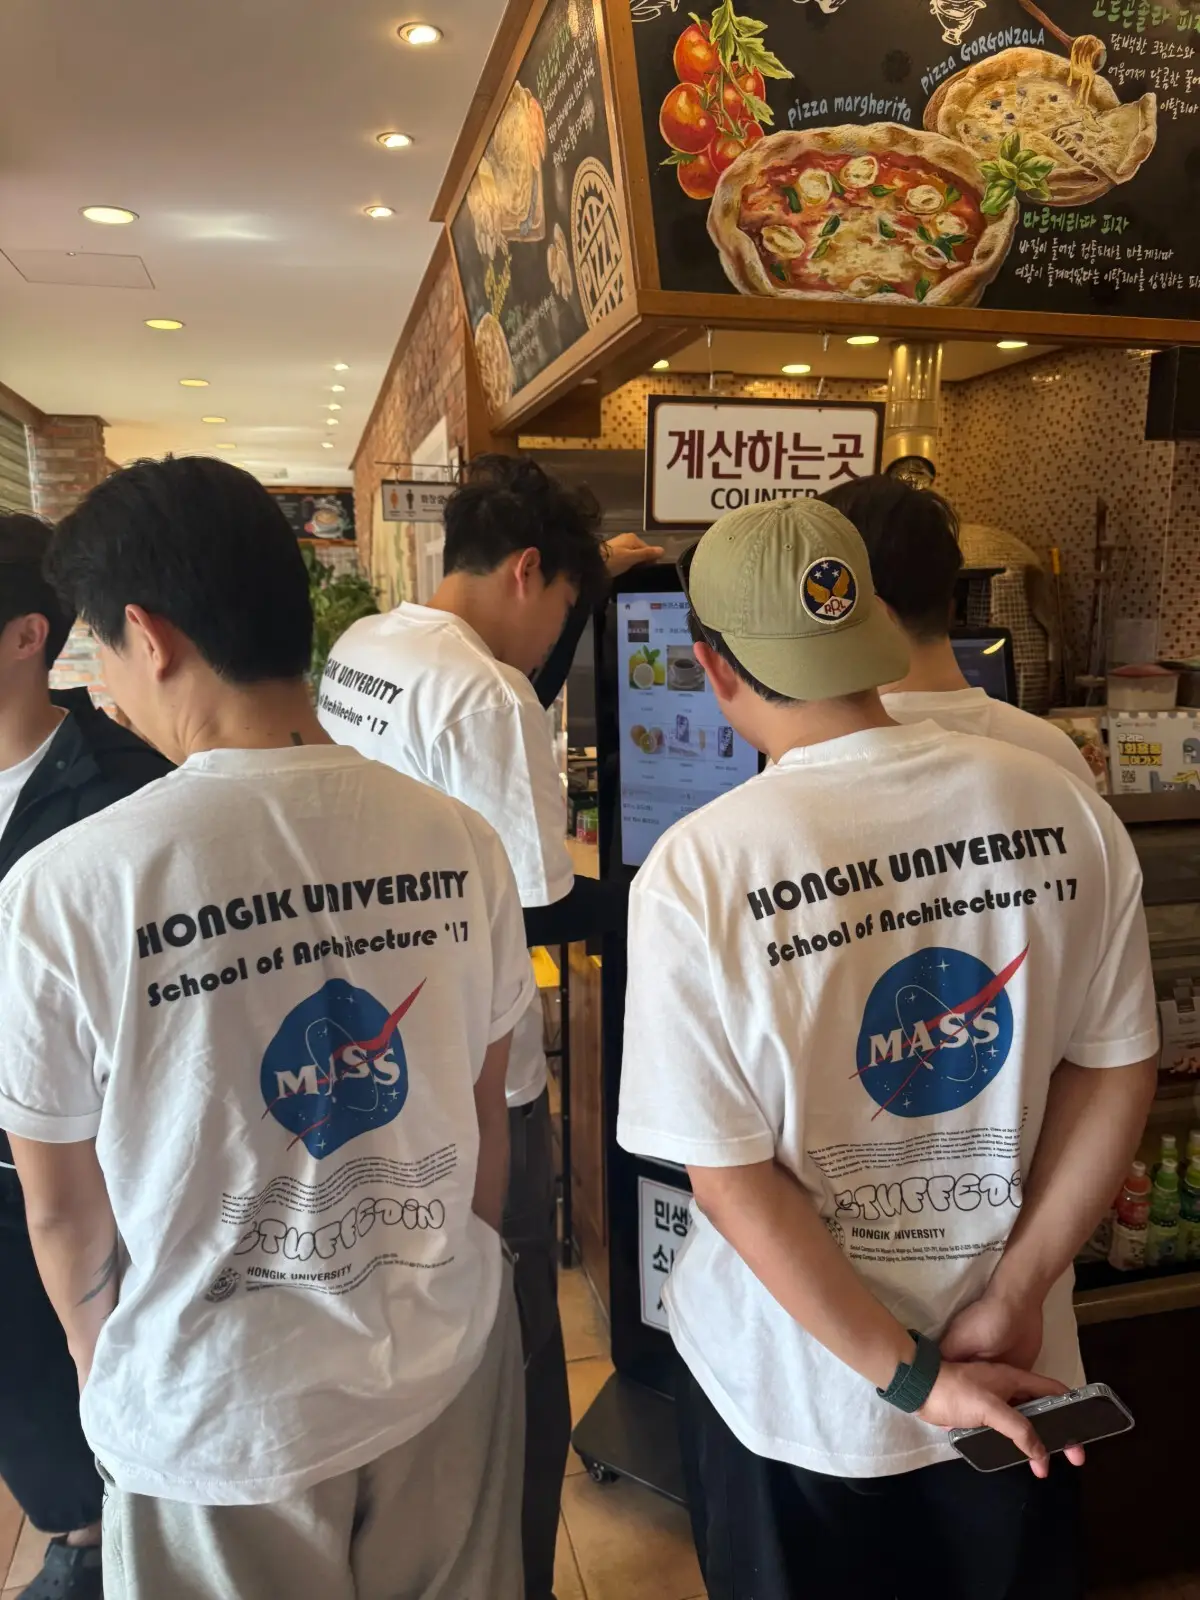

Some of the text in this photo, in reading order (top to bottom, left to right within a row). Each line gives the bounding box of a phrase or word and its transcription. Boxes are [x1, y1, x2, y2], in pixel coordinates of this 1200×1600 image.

[920, 27, 1045, 94] pizza GORGONZOLA
[1110, 33, 1195, 59] 담백한 크림소스와
[1150, 66, 1180, 90] 달콤한
[787, 92, 912, 128] pizza margherita
[1160, 97, 1199, 120] 이탈리아
[1023, 207, 1130, 235] 마르게리따 피자
[1019, 237, 1047, 260] 바질이
[1051, 237, 1077, 261] 들어간
[1126, 244, 1174, 261] 마르게리따
[1103, 268, 1146, 292] 이탈리아를
[1148, 271, 1184, 290] 상징하는
[666, 429, 865, 480] 계산하는곳
[338, 665, 404, 704] UNIVERSITY
[747, 826, 1068, 921] HONGIK UNIVERSITY
[137, 870, 469, 959] HONGIK UNIVERSITY
[767, 921, 851, 967] School
[855, 913, 874, 939] of
[880, 888, 1037, 933] Architecture
[147, 957, 249, 1008] School
[256, 947, 285, 975] of
[868, 1006, 1000, 1068] MASS
[654, 1198, 692, 1238] 민생
[852, 1226, 890, 1240] HONGIK
[247, 1262, 352, 1281] HONGIK UNIVERSITY
